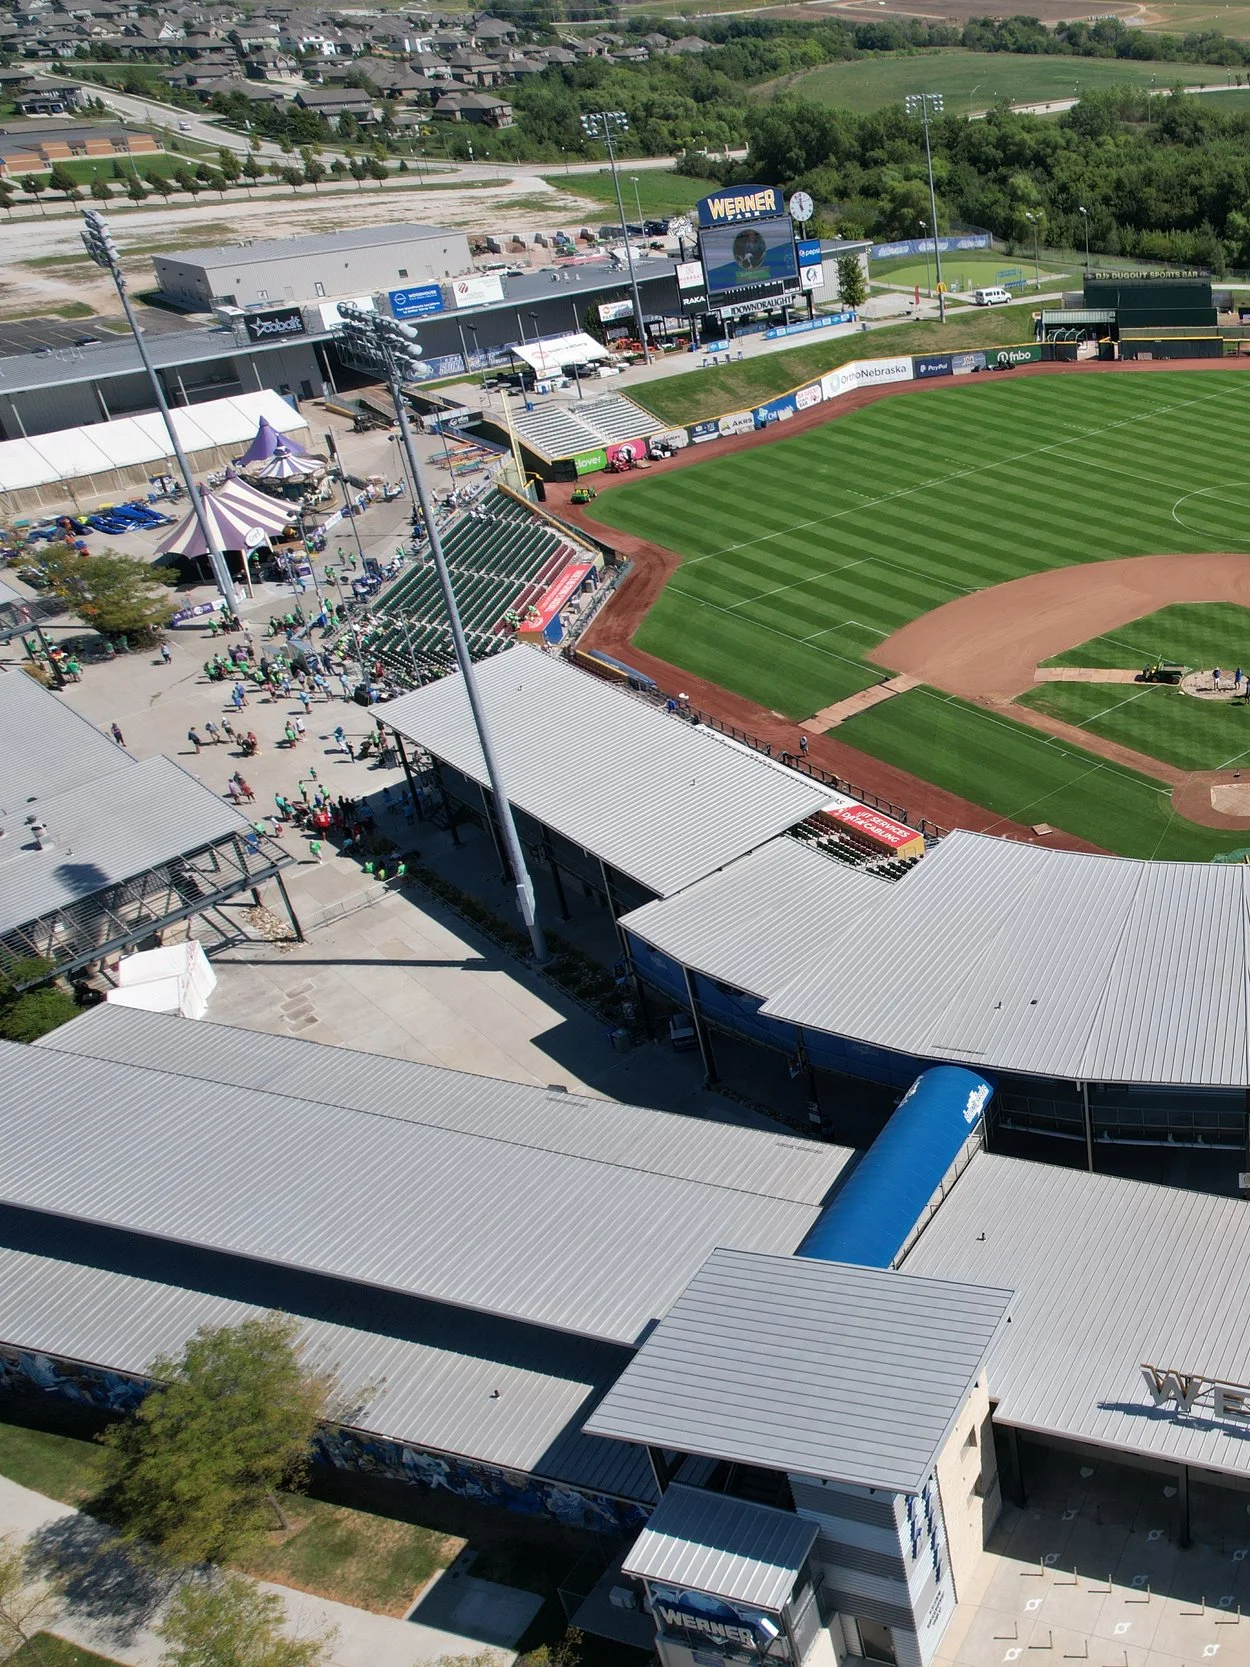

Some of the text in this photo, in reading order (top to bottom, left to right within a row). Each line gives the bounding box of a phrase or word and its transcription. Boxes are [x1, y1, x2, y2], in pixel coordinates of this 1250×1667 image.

[707, 189, 776, 220] WERNER
[728, 211, 760, 221] PARK
[805, 248, 821, 257] pepsi
[1112, 271, 1147, 279] DUGOUT
[1182, 270, 1198, 278] BAR
[683, 296, 706, 305] RAKA
[1009, 350, 1031, 362] fnbo
[928, 363, 948, 372] PayPal
[841, 365, 907, 384] OrthoNebraska
[863, 822, 900, 843] CABLING
[870, 817, 910, 838] SERVICES
[658, 1605, 755, 1647] WERNER
